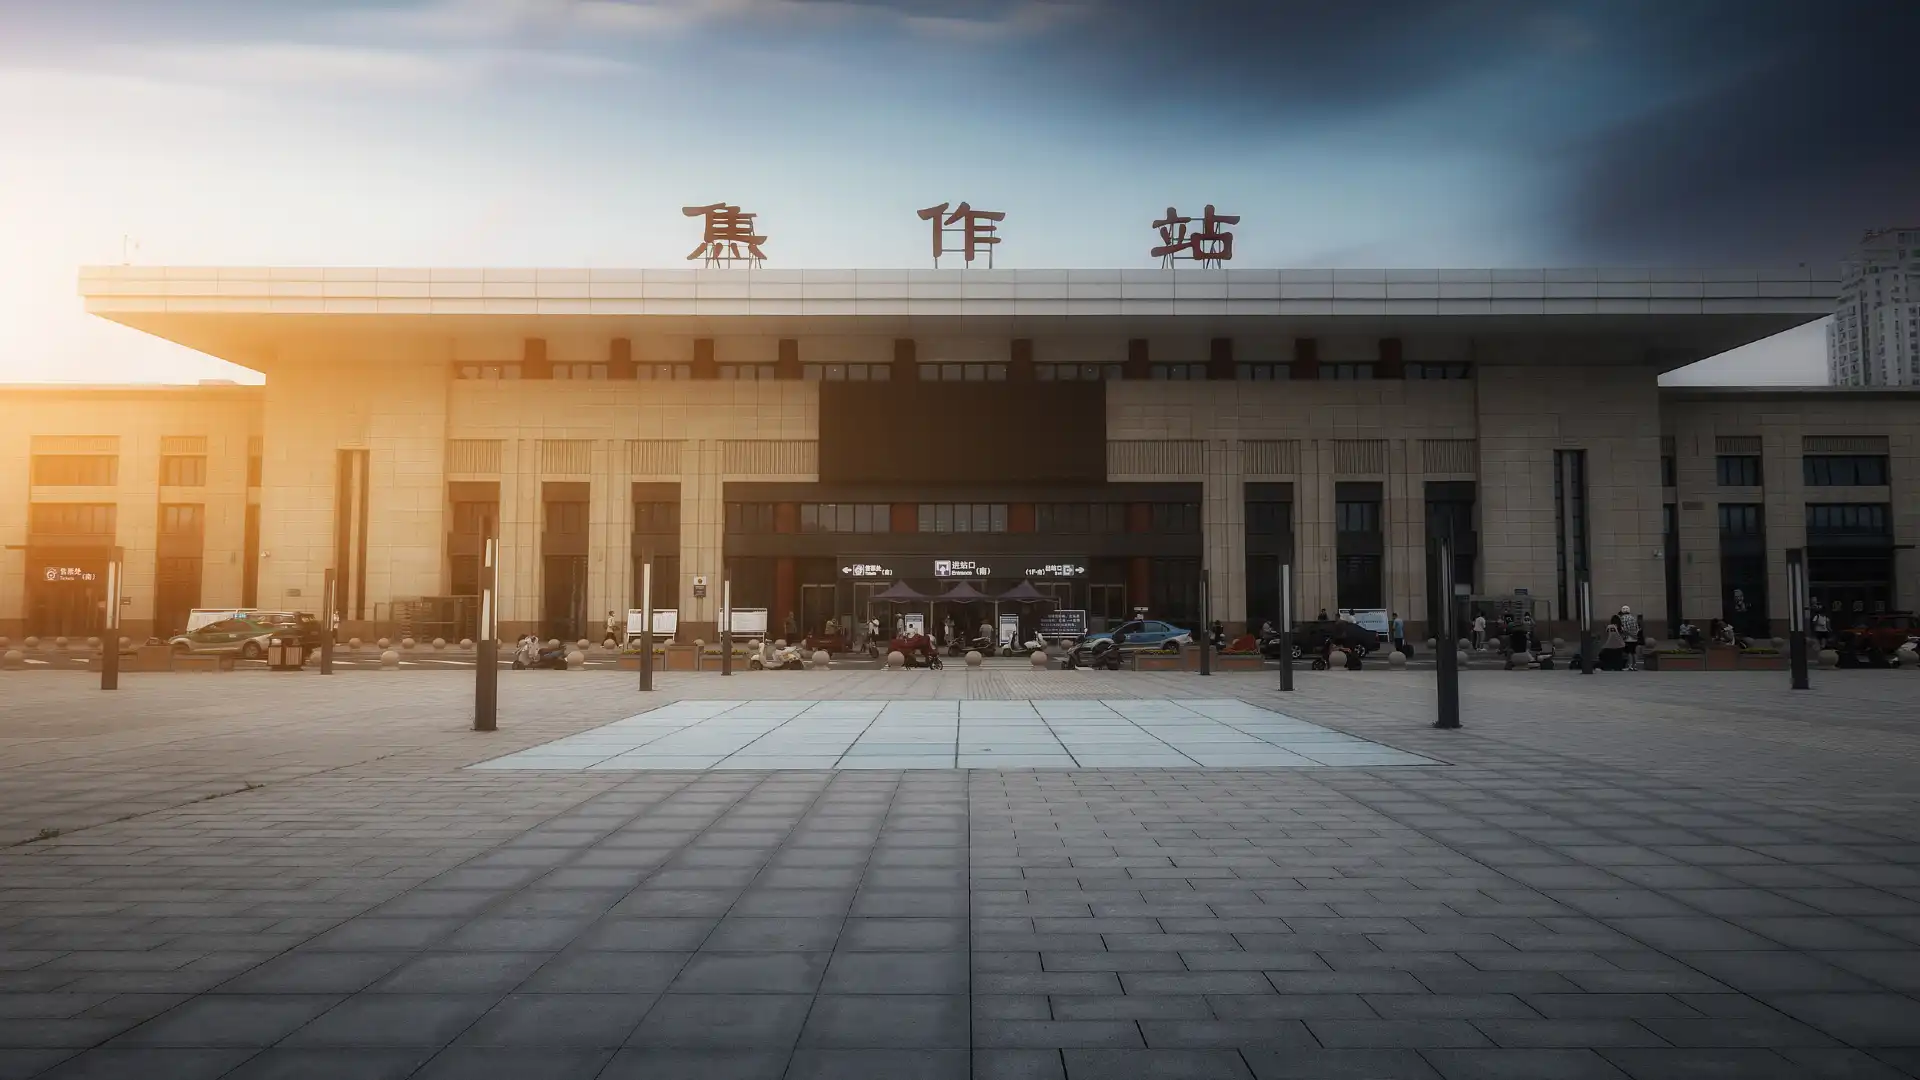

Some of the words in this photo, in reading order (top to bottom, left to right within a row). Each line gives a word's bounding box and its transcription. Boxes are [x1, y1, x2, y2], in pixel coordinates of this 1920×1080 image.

[682, 202, 1240, 261] 焦作站
[951, 561, 976, 570] 进站口
[60, 567, 82, 576] 售票处
